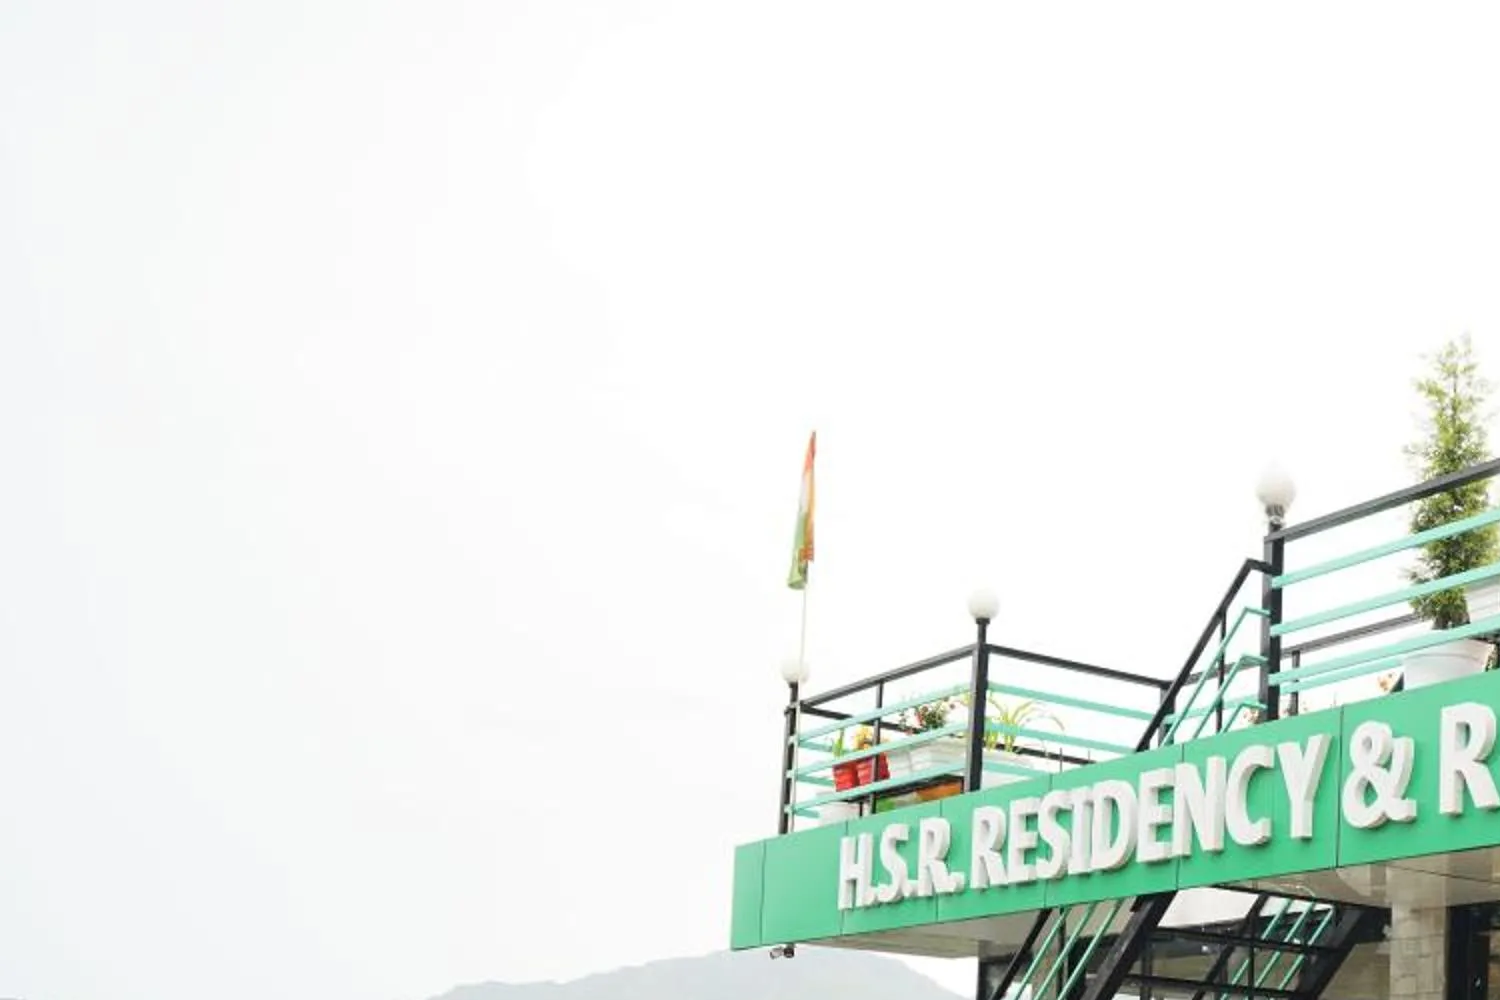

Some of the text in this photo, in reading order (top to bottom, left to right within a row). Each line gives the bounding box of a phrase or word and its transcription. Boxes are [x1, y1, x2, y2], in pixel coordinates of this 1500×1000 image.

[838, 812, 966, 911] H.S.R.
[969, 732, 1333, 889] RESIDENCY
[1341, 721, 1417, 829] &
